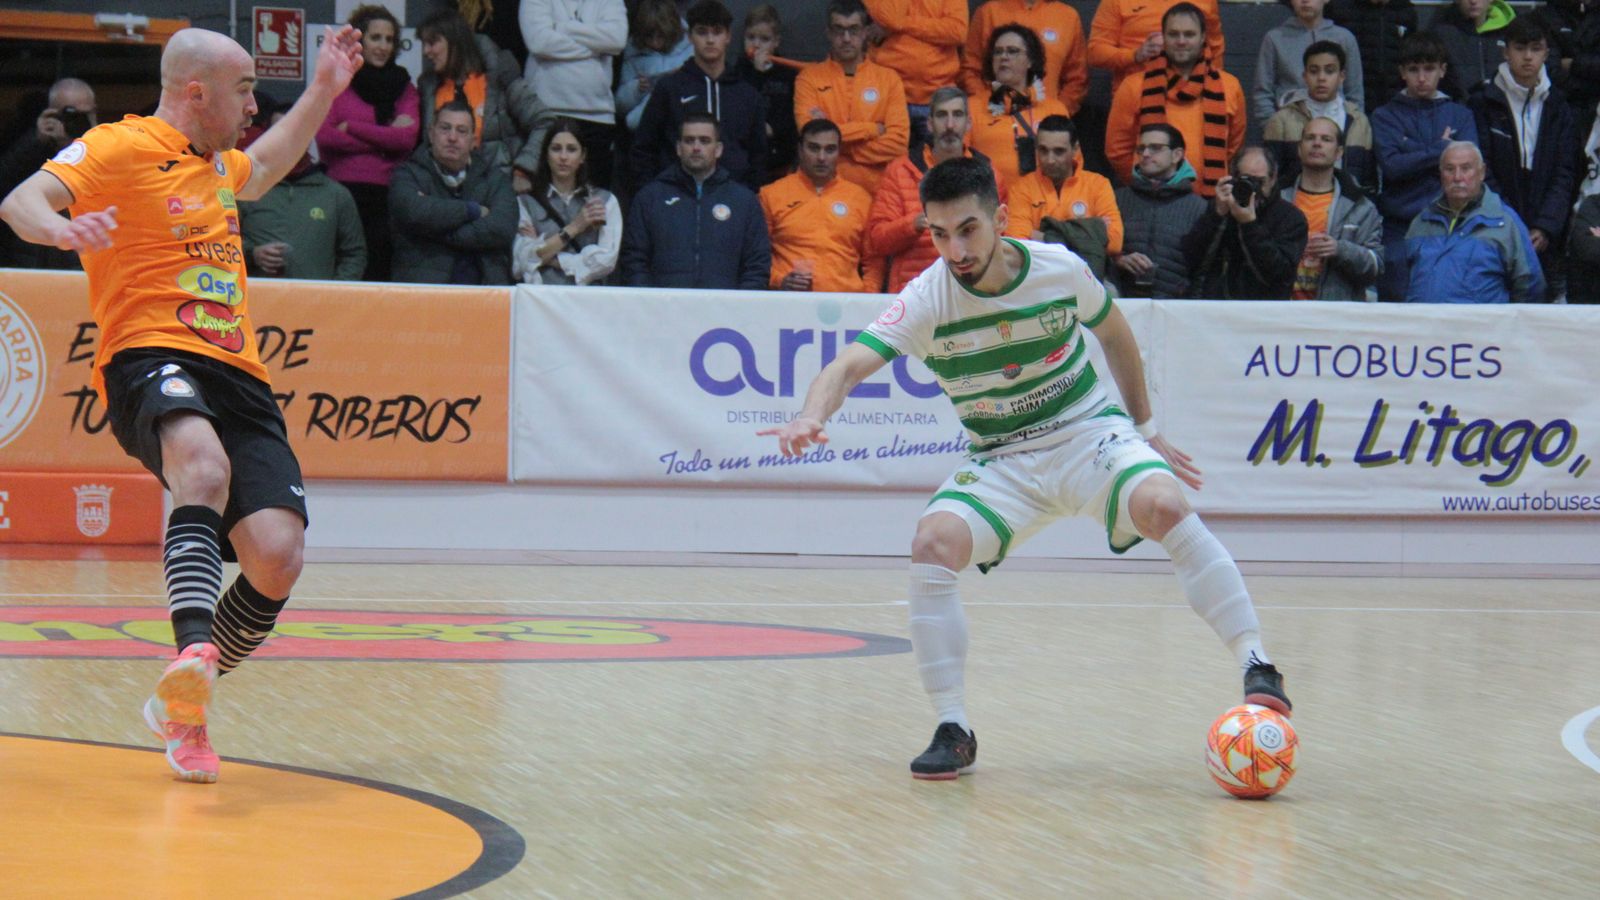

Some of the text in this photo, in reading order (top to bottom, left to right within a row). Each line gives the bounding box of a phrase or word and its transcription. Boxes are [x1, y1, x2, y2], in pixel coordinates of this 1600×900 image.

[1245, 344, 1503, 379] AUTOBUSES
[304, 392, 482, 444] RIBEROS
[837, 412, 939, 425] ALIMENTARIA
[1246, 398, 1332, 467] M.
[660, 449, 713, 475] Todo
[719, 456, 751, 470] un
[758, 443, 837, 468] mundo
[843, 447, 870, 461] en
